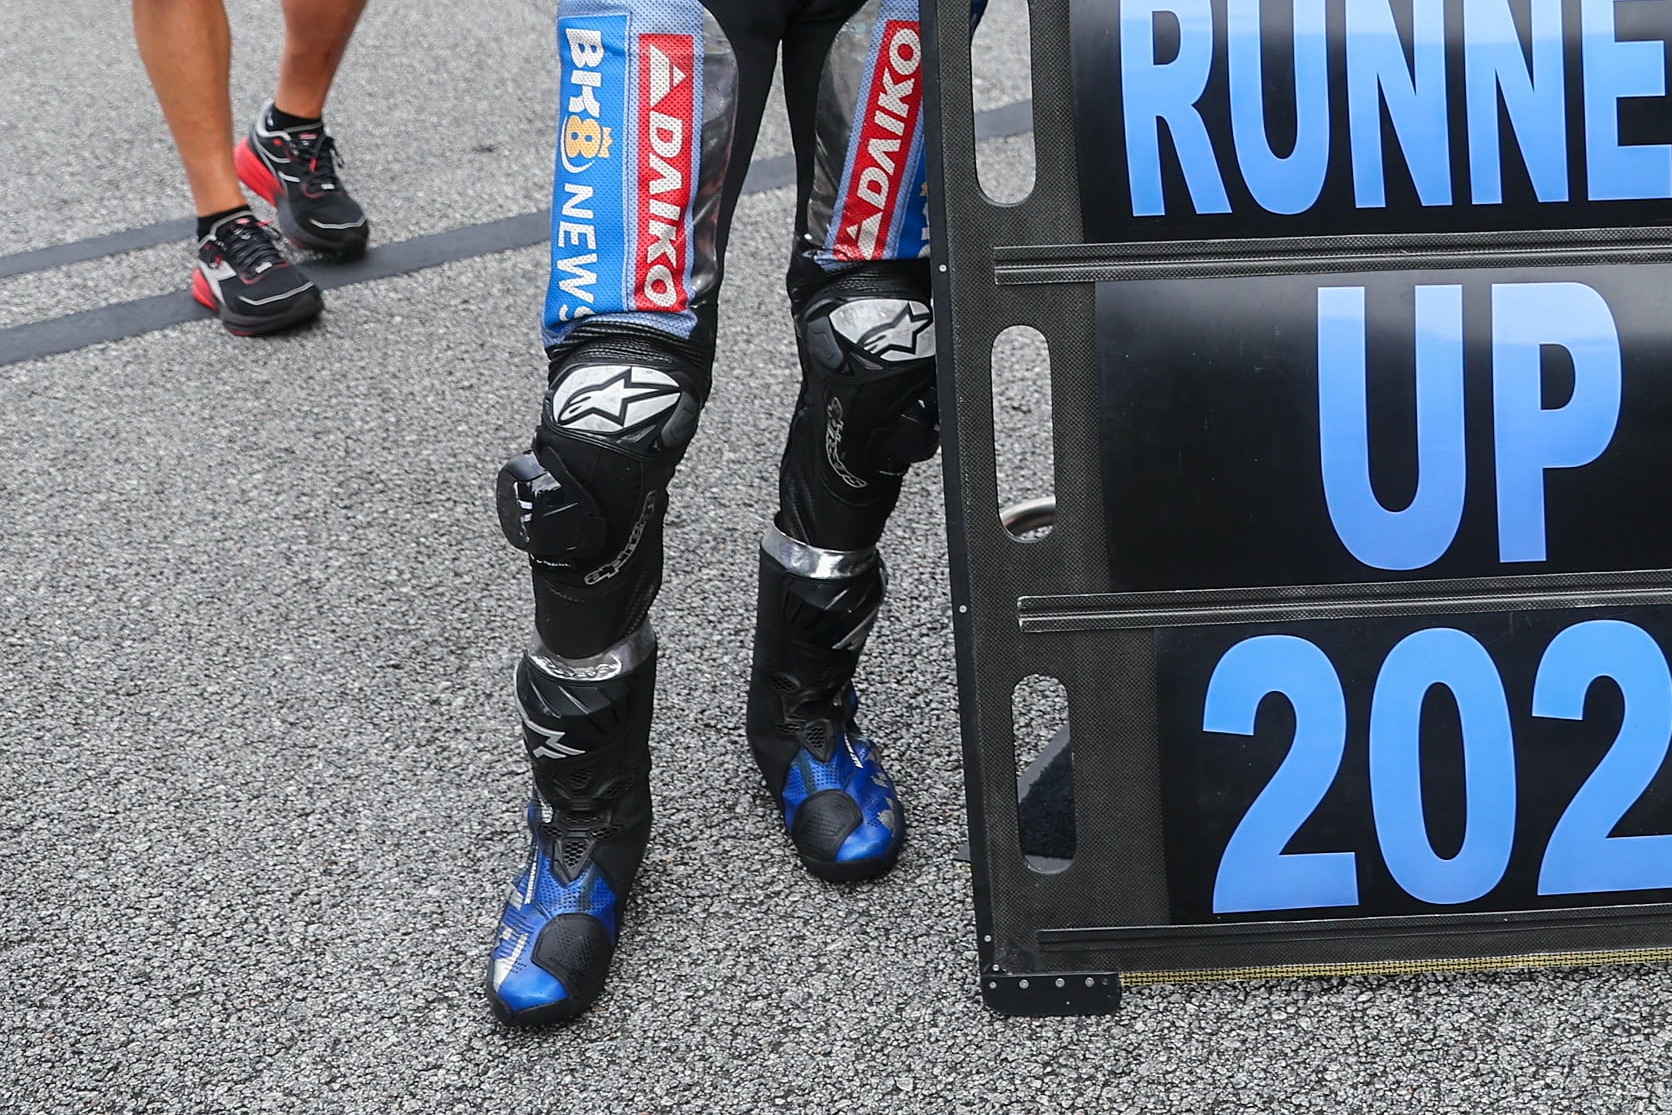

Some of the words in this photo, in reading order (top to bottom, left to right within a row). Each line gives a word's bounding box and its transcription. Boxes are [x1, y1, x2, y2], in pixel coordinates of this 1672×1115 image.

[643, 113, 683, 309] DAIKO
[857, 28, 921, 209] DAIKO
[1317, 281, 1622, 571] UP
